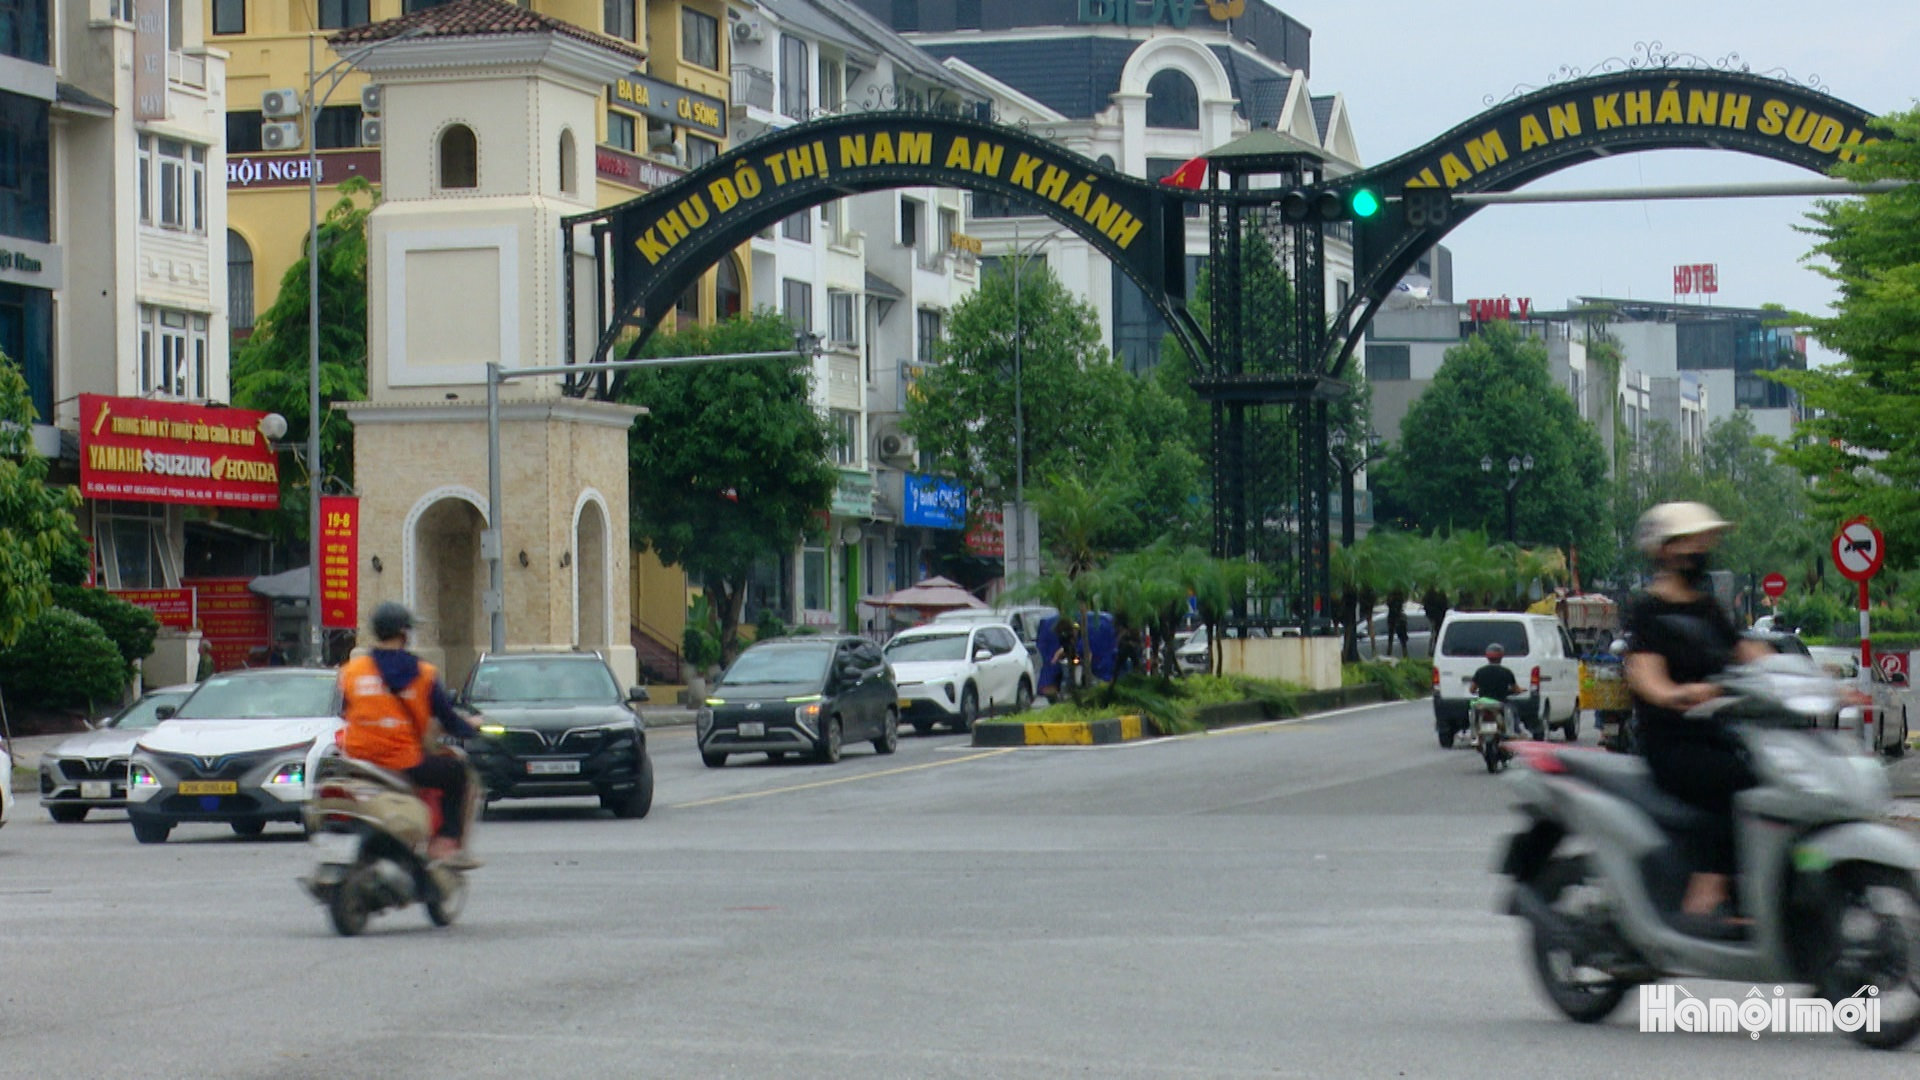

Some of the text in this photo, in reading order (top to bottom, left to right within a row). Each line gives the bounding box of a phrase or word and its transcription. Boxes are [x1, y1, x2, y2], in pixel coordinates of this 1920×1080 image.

[618, 78, 633, 102] BA
[634, 82, 650, 107] BA
[1520, 101, 1582, 151] AN
[1592, 79, 1751, 130] KHÁNH
[227, 158, 263, 186] HỘI
[635, 192, 710, 266] KHU
[708, 157, 762, 213] ĐÔ
[764, 140, 829, 179] THỊ
[839, 132, 933, 168] NAM
[945, 136, 1004, 177] AN
[1009, 152, 1143, 250] KHÁNH
[1673, 263, 1718, 294] HOTEL
[88, 444, 278, 483] YAMAHA SUZUKI HONDA
[328, 512, 350, 528] 19-8
